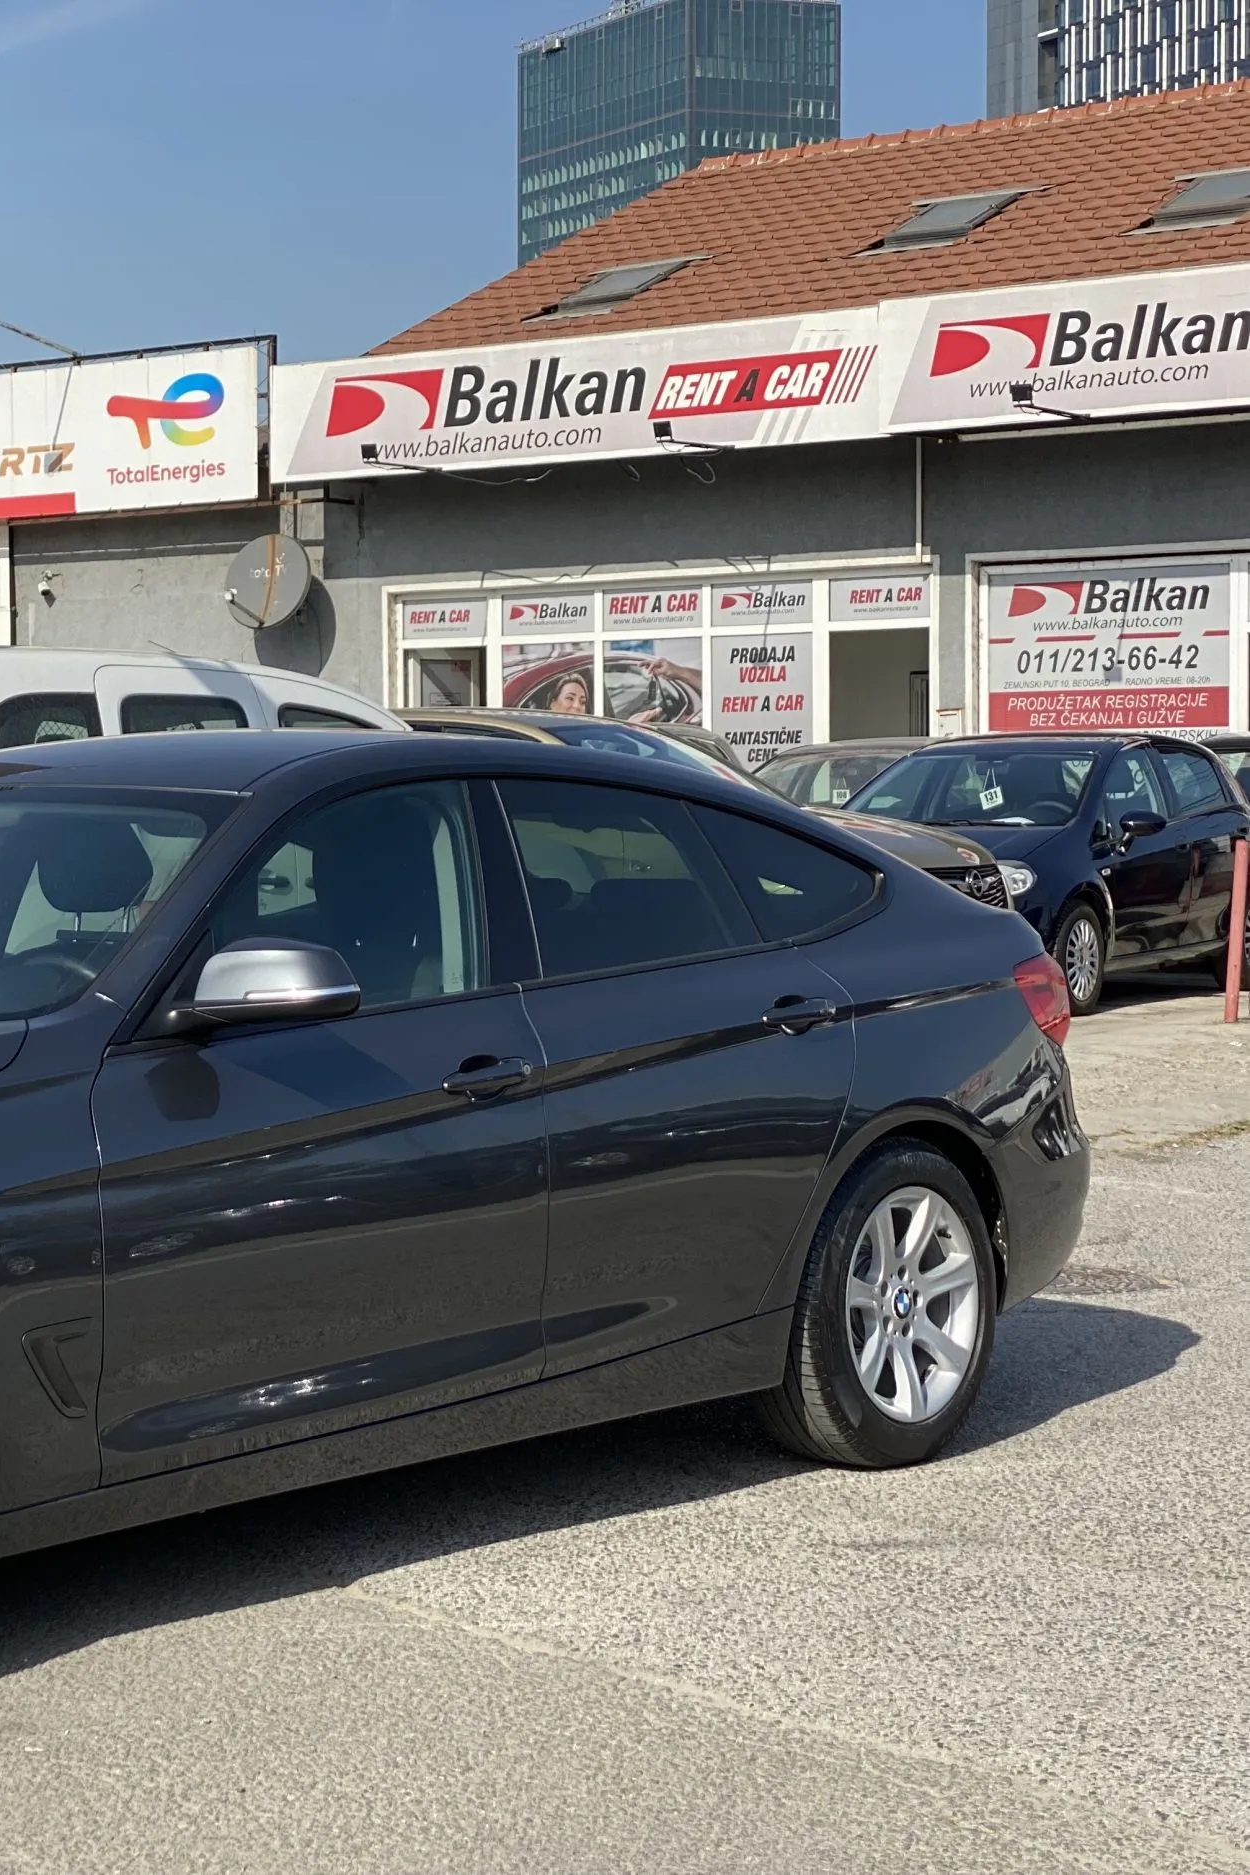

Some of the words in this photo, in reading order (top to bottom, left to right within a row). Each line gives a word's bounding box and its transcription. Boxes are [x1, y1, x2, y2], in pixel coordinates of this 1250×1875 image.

[1049, 301, 1250, 366] Balkan
[970, 363, 1208, 397] wwbalkanauto.com
[444, 357, 646, 428] Balkan
[655, 370, 738, 411] RENT
[734, 369, 760, 403] A
[763, 362, 830, 402] CAR
[107, 459, 226, 485] TotalEnergies
[609, 595, 649, 615] RENT
[651, 595, 662, 613] A
[667, 593, 698, 611] CAR
[752, 591, 806, 608] Balkan
[850, 589, 882, 604] RENT
[884, 588, 893, 602] A
[897, 587, 922, 602] CAR
[1084, 577, 1210, 614] Balkan
[410, 610, 437, 624] RENT
[438, 610, 446, 623] A
[449, 609, 470, 623] CAR
[539, 603, 587, 618] Balkan
[1033, 616, 1183, 632] www.balkanauto.com
[730, 645, 795, 664] PRODAJA
[1017, 644, 1199, 674] 011/213-66-42
[739, 665, 787, 683] VOZILA
[1072, 678, 1110, 687] BEOGRAD
[1125, 677, 1153, 686] RADNO
[721, 695, 758, 713] RENT
[760, 695, 770, 712] A
[775, 694, 804, 711] CAR
[1007, 693, 1101, 711] PRODUŽETAK
[1105, 692, 1209, 708] REGISTRACIJE
[1029, 711, 1056, 727] BEZ
[1060, 709, 1124, 726] ČEKANJA
[1128, 712, 1133, 724] I
[1136, 708, 1185, 724] GUŽVE
[725, 726, 802, 746] FANTASTIČNE
[984, 790, 999, 803] 131
